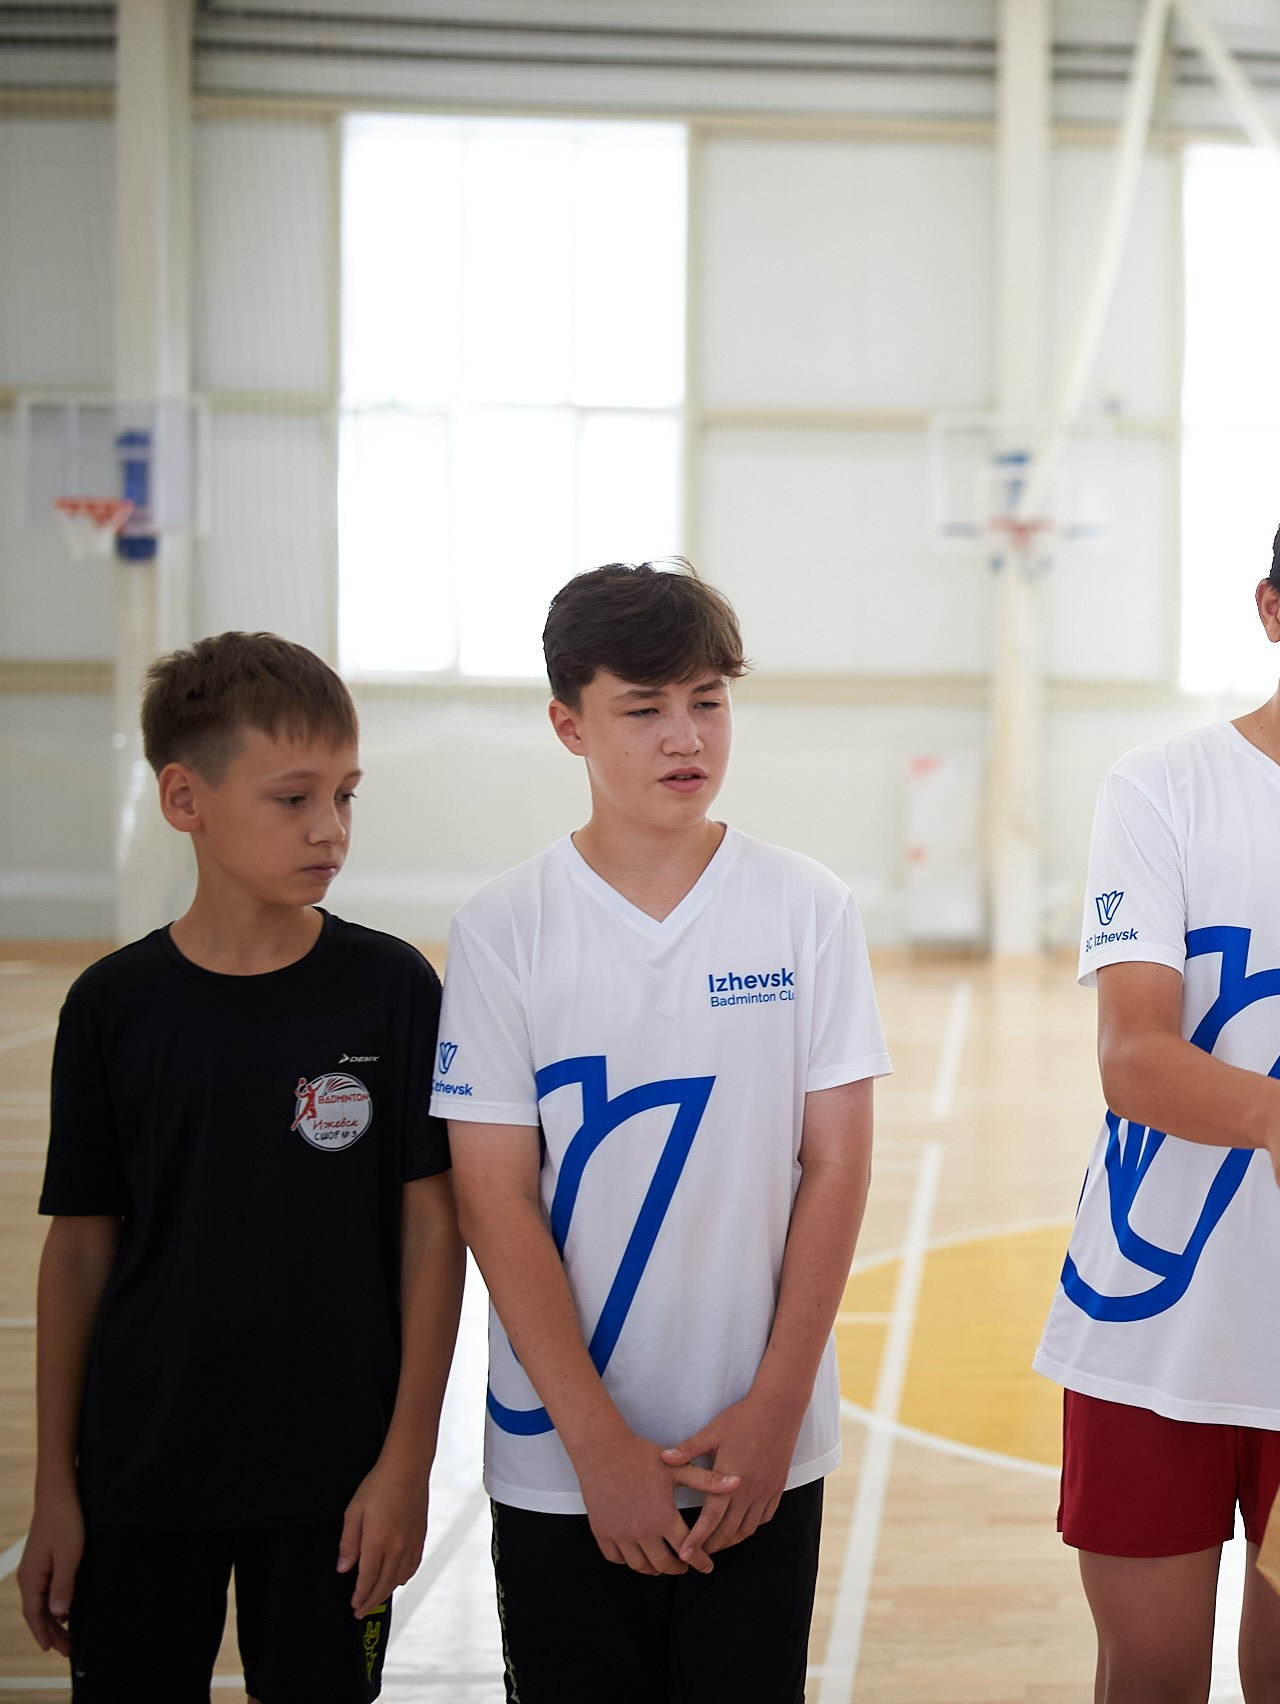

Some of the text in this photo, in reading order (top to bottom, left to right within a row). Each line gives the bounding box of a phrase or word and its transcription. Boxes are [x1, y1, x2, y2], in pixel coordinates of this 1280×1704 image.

[1094, 927, 1139, 946] Izhevsk
[708, 967, 795, 993] Izhevsk
[711, 992, 776, 1007] Badminton
[318, 1093, 369, 1104] BADMINTON
[313, 1117, 359, 1130] Ижевск
